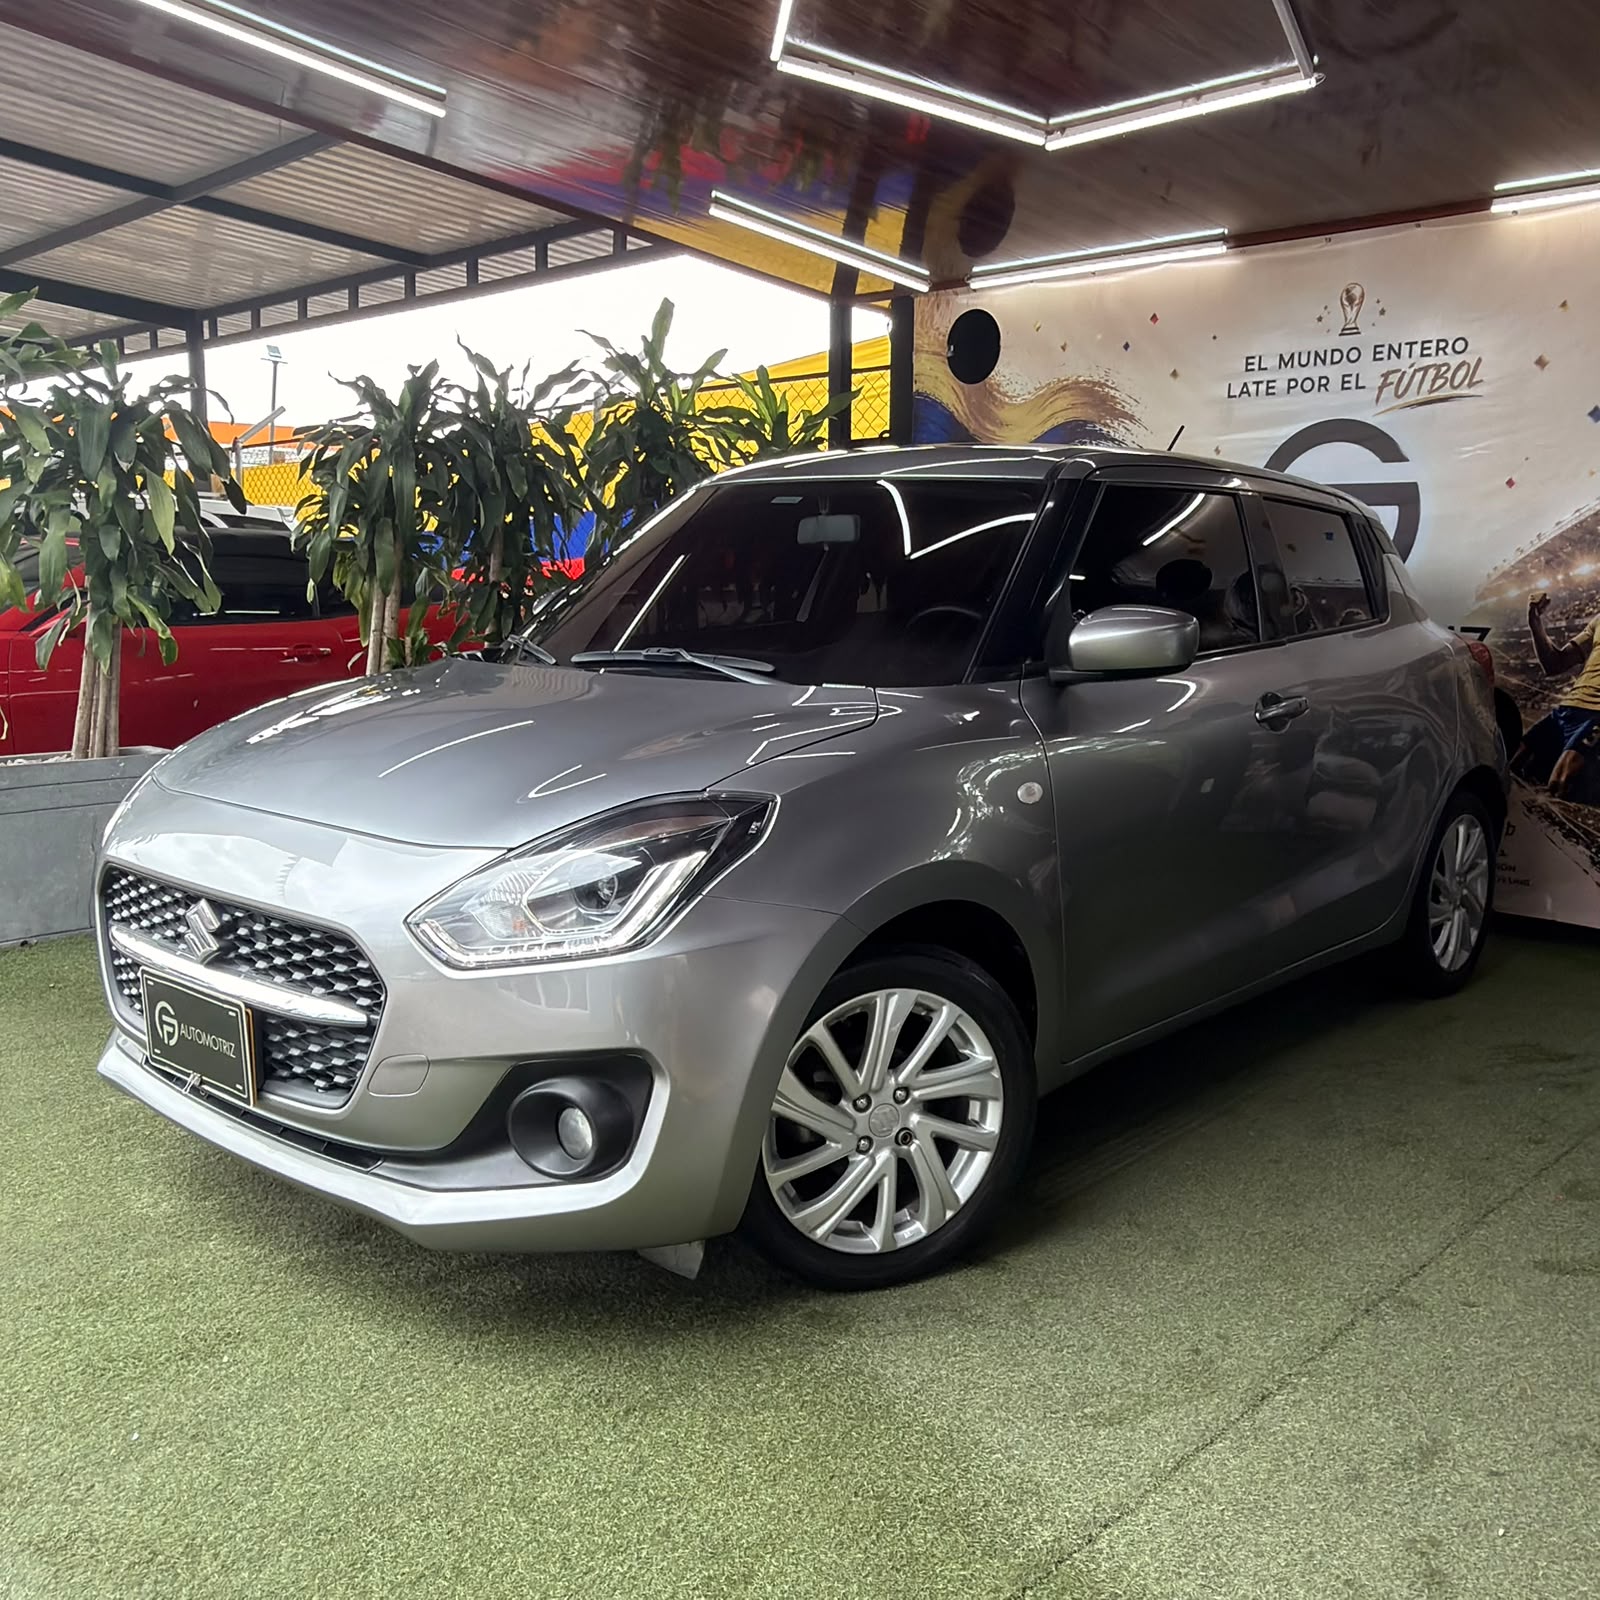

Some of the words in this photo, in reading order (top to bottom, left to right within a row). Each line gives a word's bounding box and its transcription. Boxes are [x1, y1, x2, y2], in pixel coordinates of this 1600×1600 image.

[1244, 355, 1268, 373] EL
[1277, 347, 1362, 369] MUNDO
[1372, 336, 1469, 362] ENTERO
[1226, 379, 1277, 399] LATE
[1286, 376, 1330, 394] POR
[1341, 373, 1366, 390] EL
[1374, 357, 1484, 405] FÚTBOL
[180, 1023, 236, 1058] AUTOMOTRIZ
